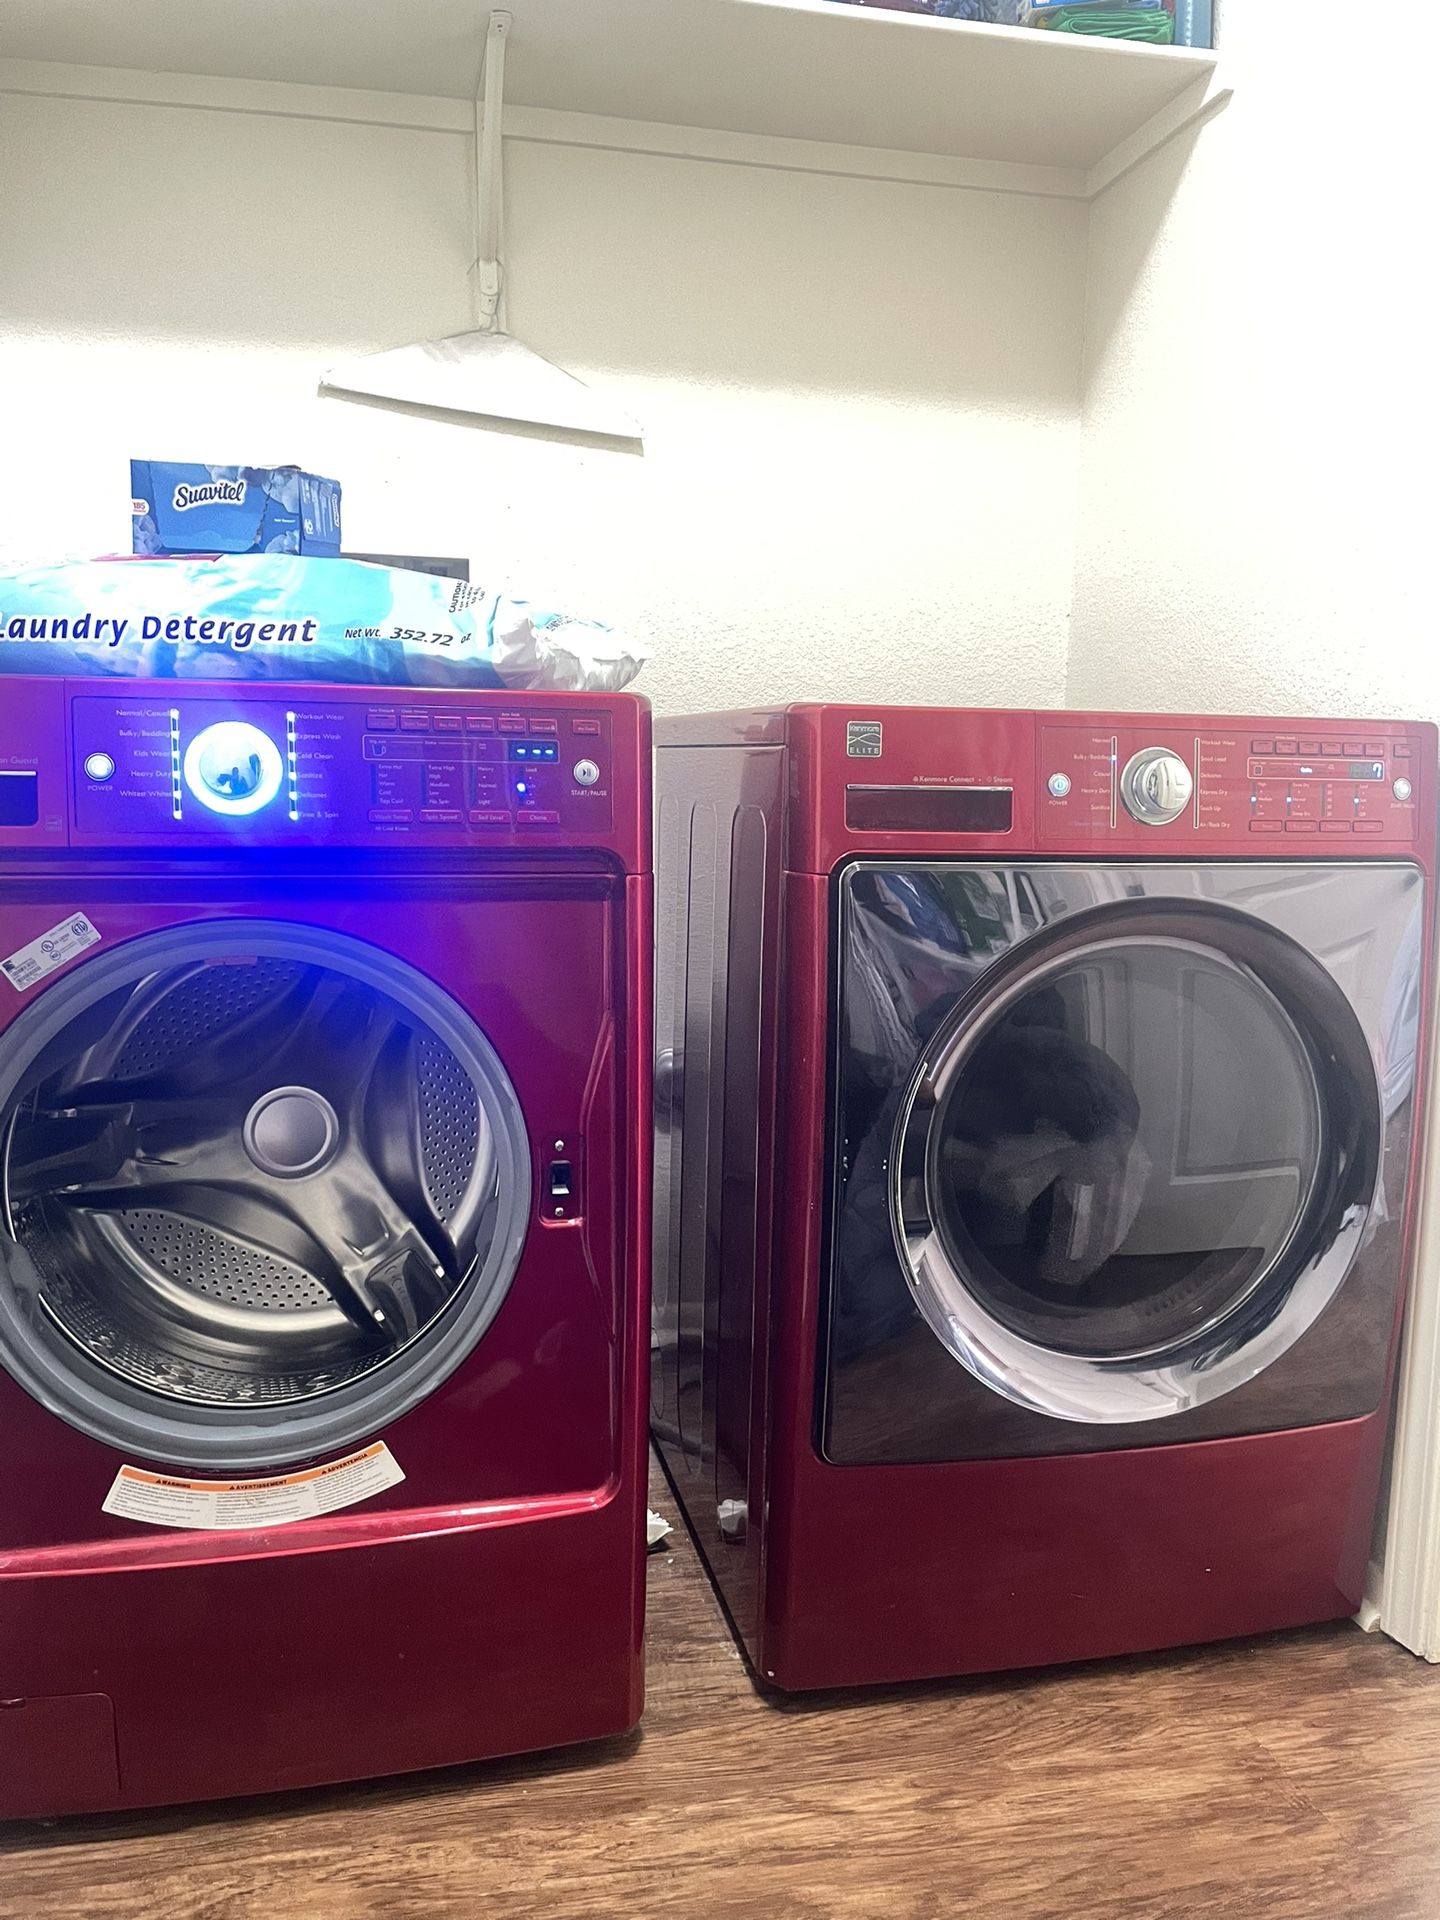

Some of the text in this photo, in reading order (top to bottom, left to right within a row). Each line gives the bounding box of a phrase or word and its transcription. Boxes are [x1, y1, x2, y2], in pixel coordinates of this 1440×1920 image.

[175, 482, 244, 508] Suavitel
[0, 613, 317, 648] aundry Detergent
[345, 629, 363, 638] Net
[390, 627, 454, 647] 352.72
[849, 747, 879, 755] ELITE
[327, 1453, 369, 1473] ADVERTENCIA
[162, 1480, 191, 1489] WARNING
[235, 1479, 288, 1490] AVERTISSEMENT
